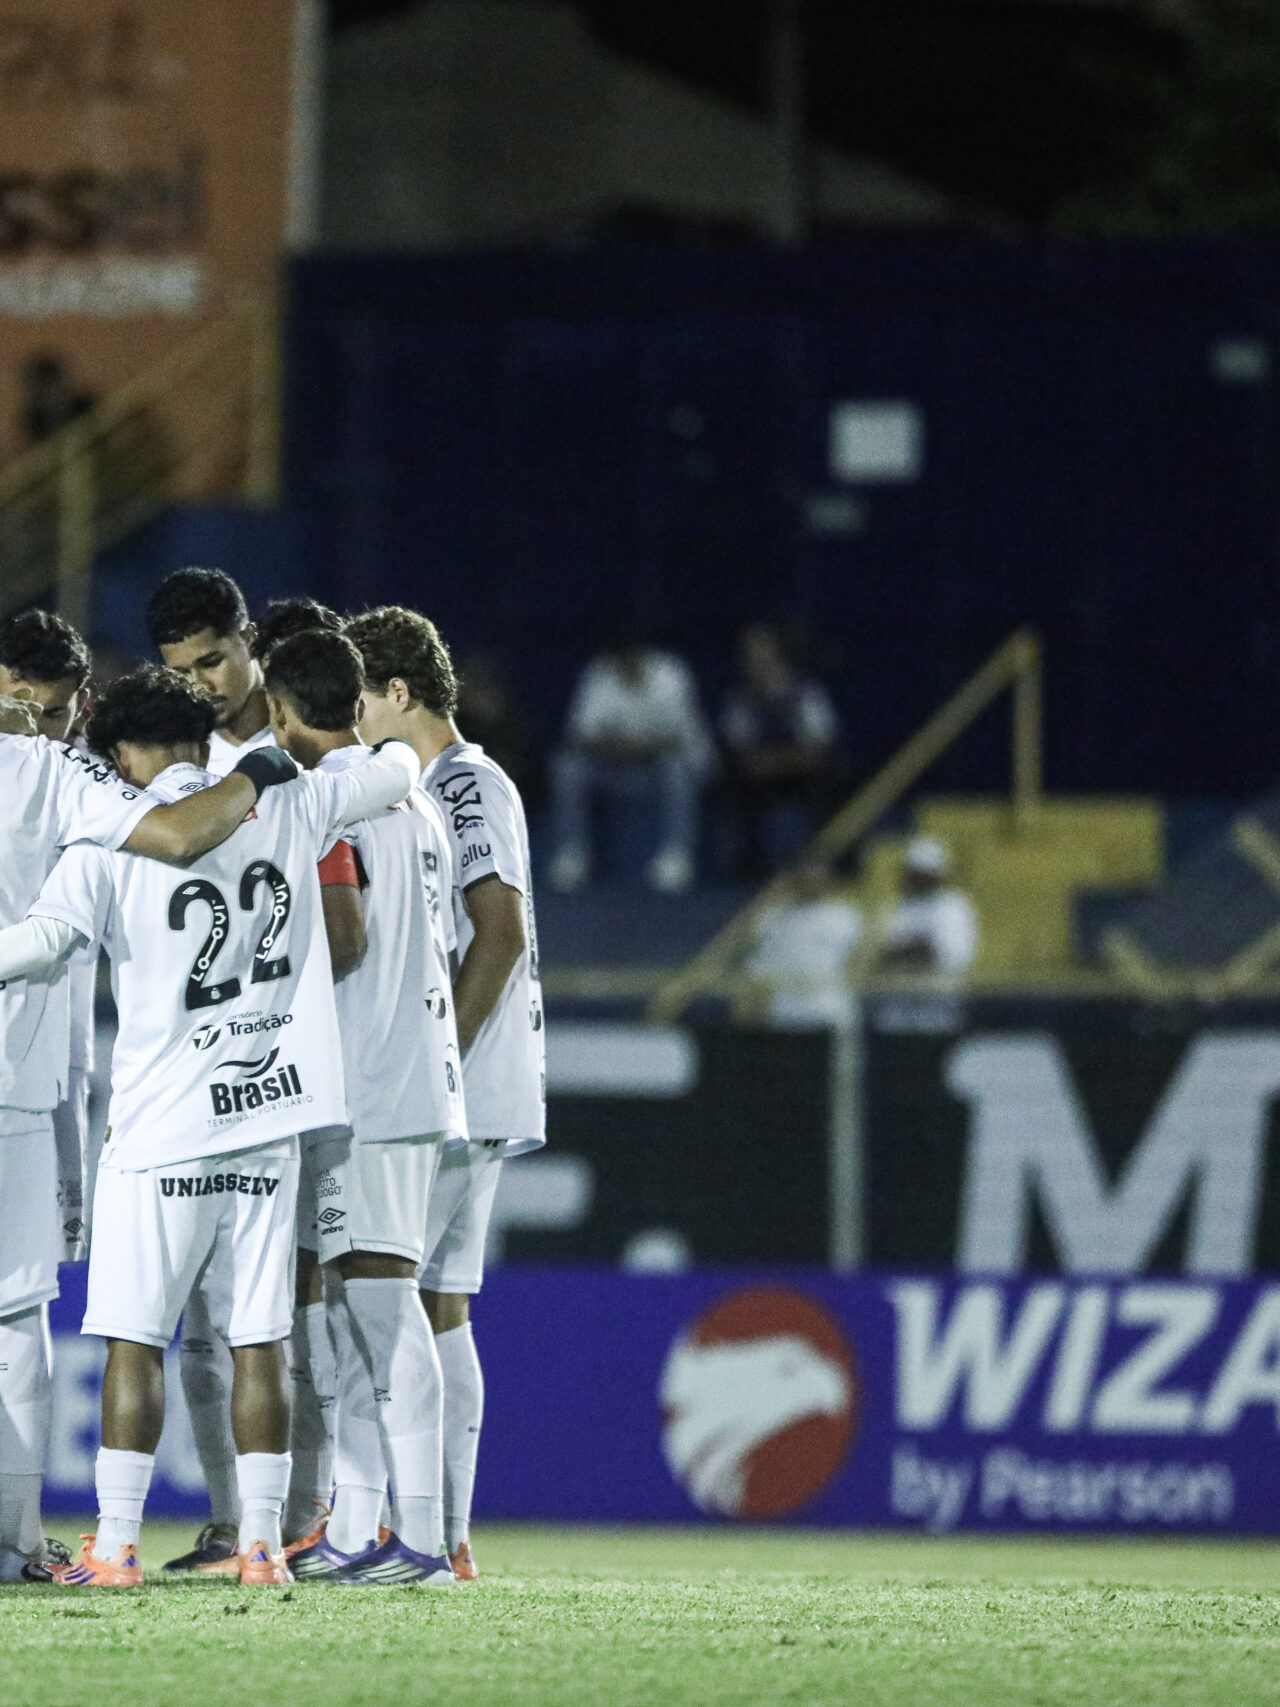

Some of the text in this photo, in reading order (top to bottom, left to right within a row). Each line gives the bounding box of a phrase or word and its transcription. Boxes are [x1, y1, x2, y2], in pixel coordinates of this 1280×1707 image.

[461, 843, 492, 868] allu
[168, 860, 291, 1010] 22
[227, 1014, 294, 1036] Tradição
[210, 1064, 302, 1116] Brasil
[207, 1112, 256, 1128] TERMINAL
[160, 1173, 280, 1197] UNIASSELV
[321, 1225, 344, 1236] umbro
[980, 1450, 1234, 1521] Pearson
